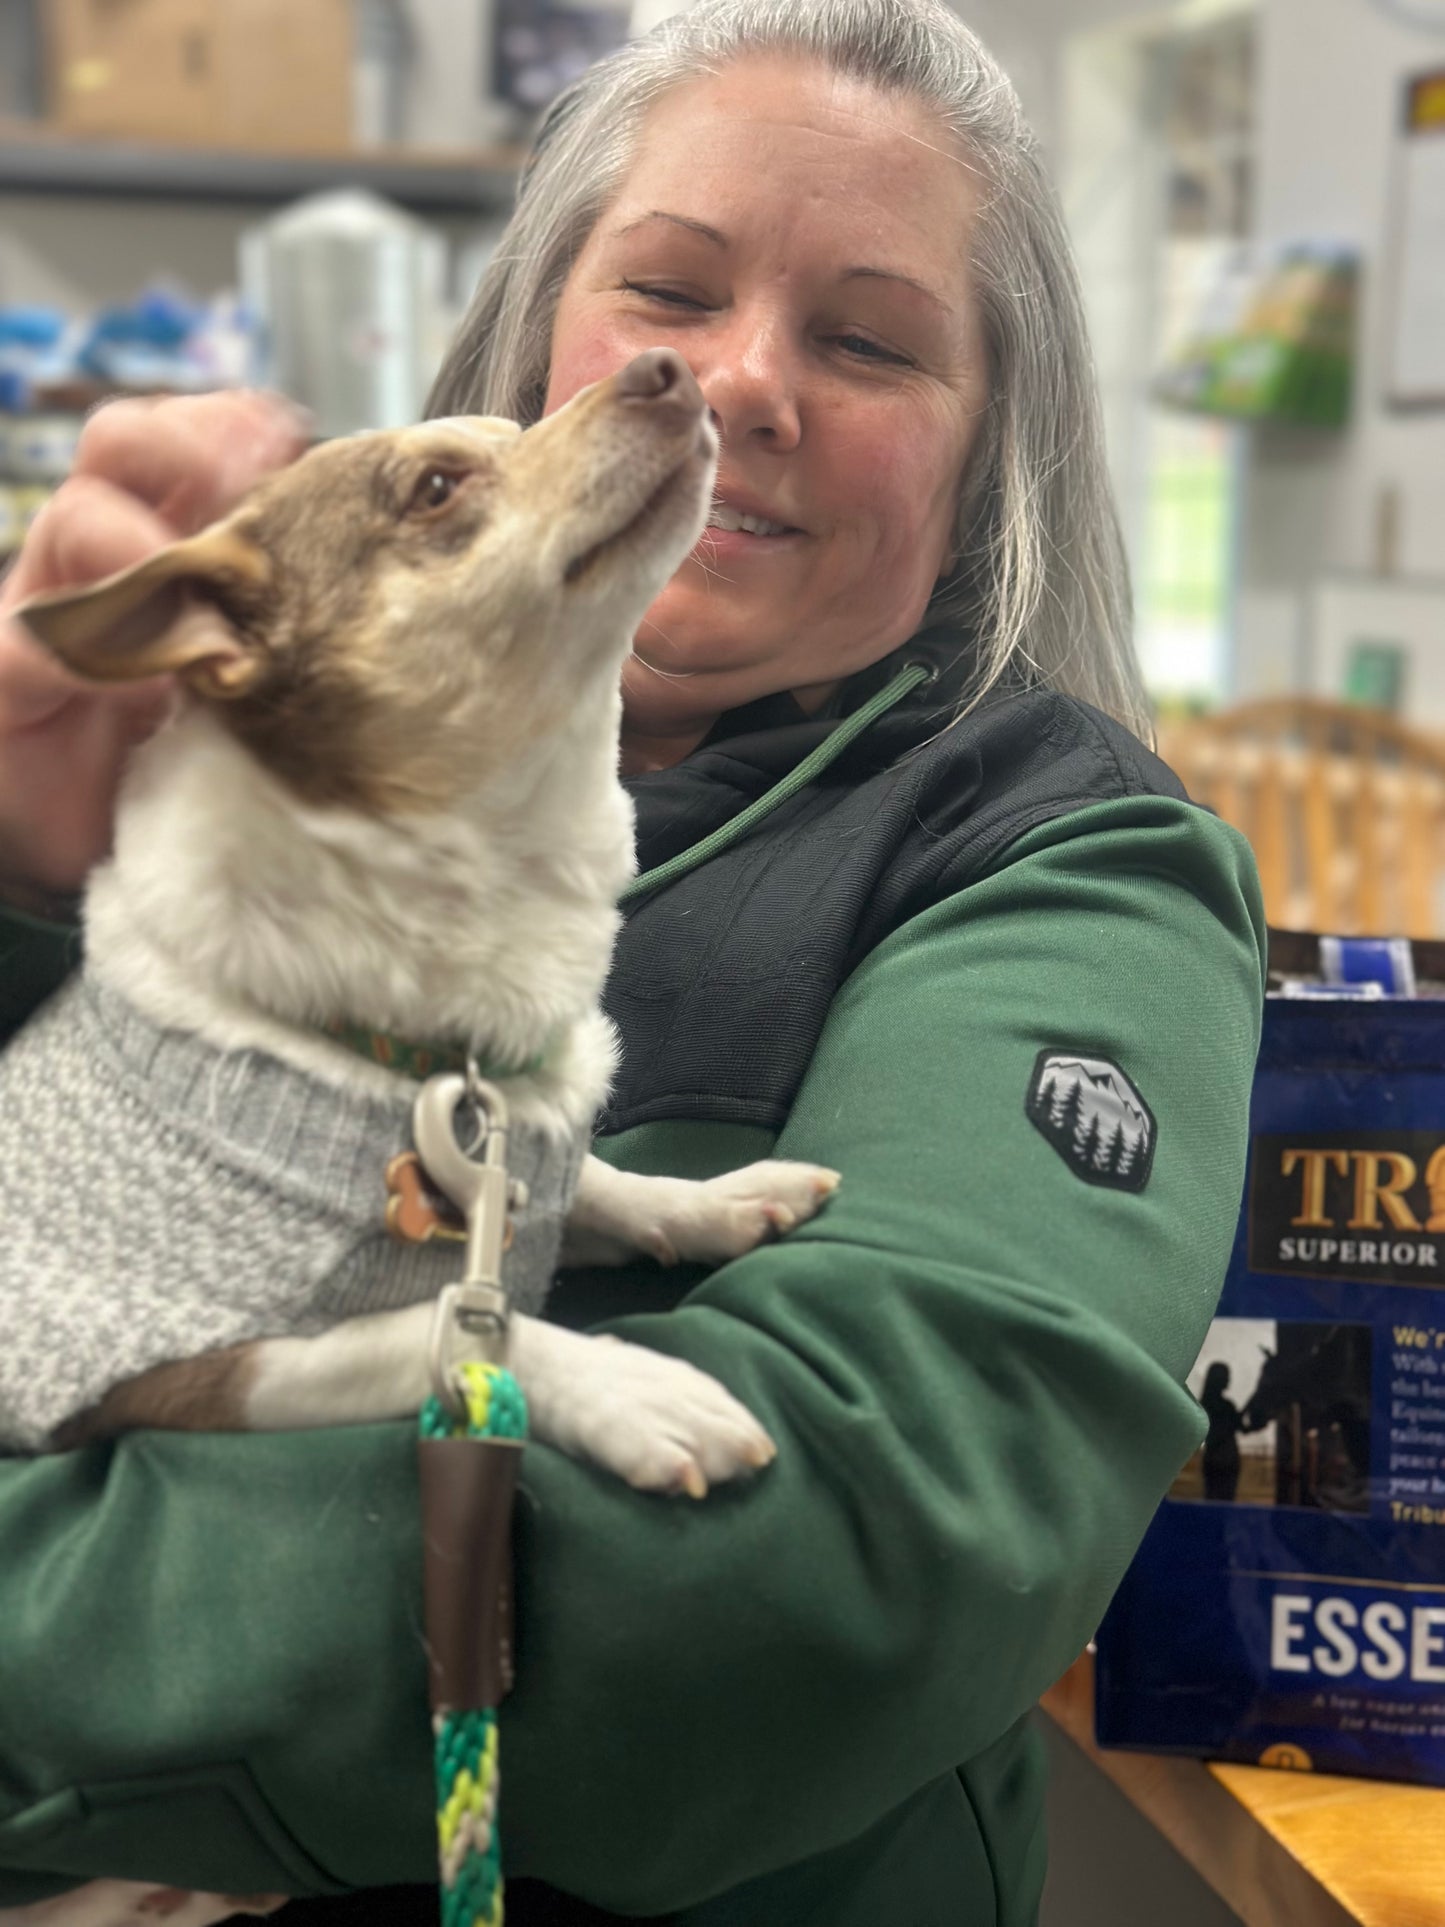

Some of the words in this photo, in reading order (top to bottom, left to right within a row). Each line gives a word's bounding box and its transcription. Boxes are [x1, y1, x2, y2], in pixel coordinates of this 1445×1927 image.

[1279, 1237, 1438, 1267] SUPERIOR
[1389, 1478, 1428, 1495] your
[1271, 1594, 1445, 1684] ESSE
